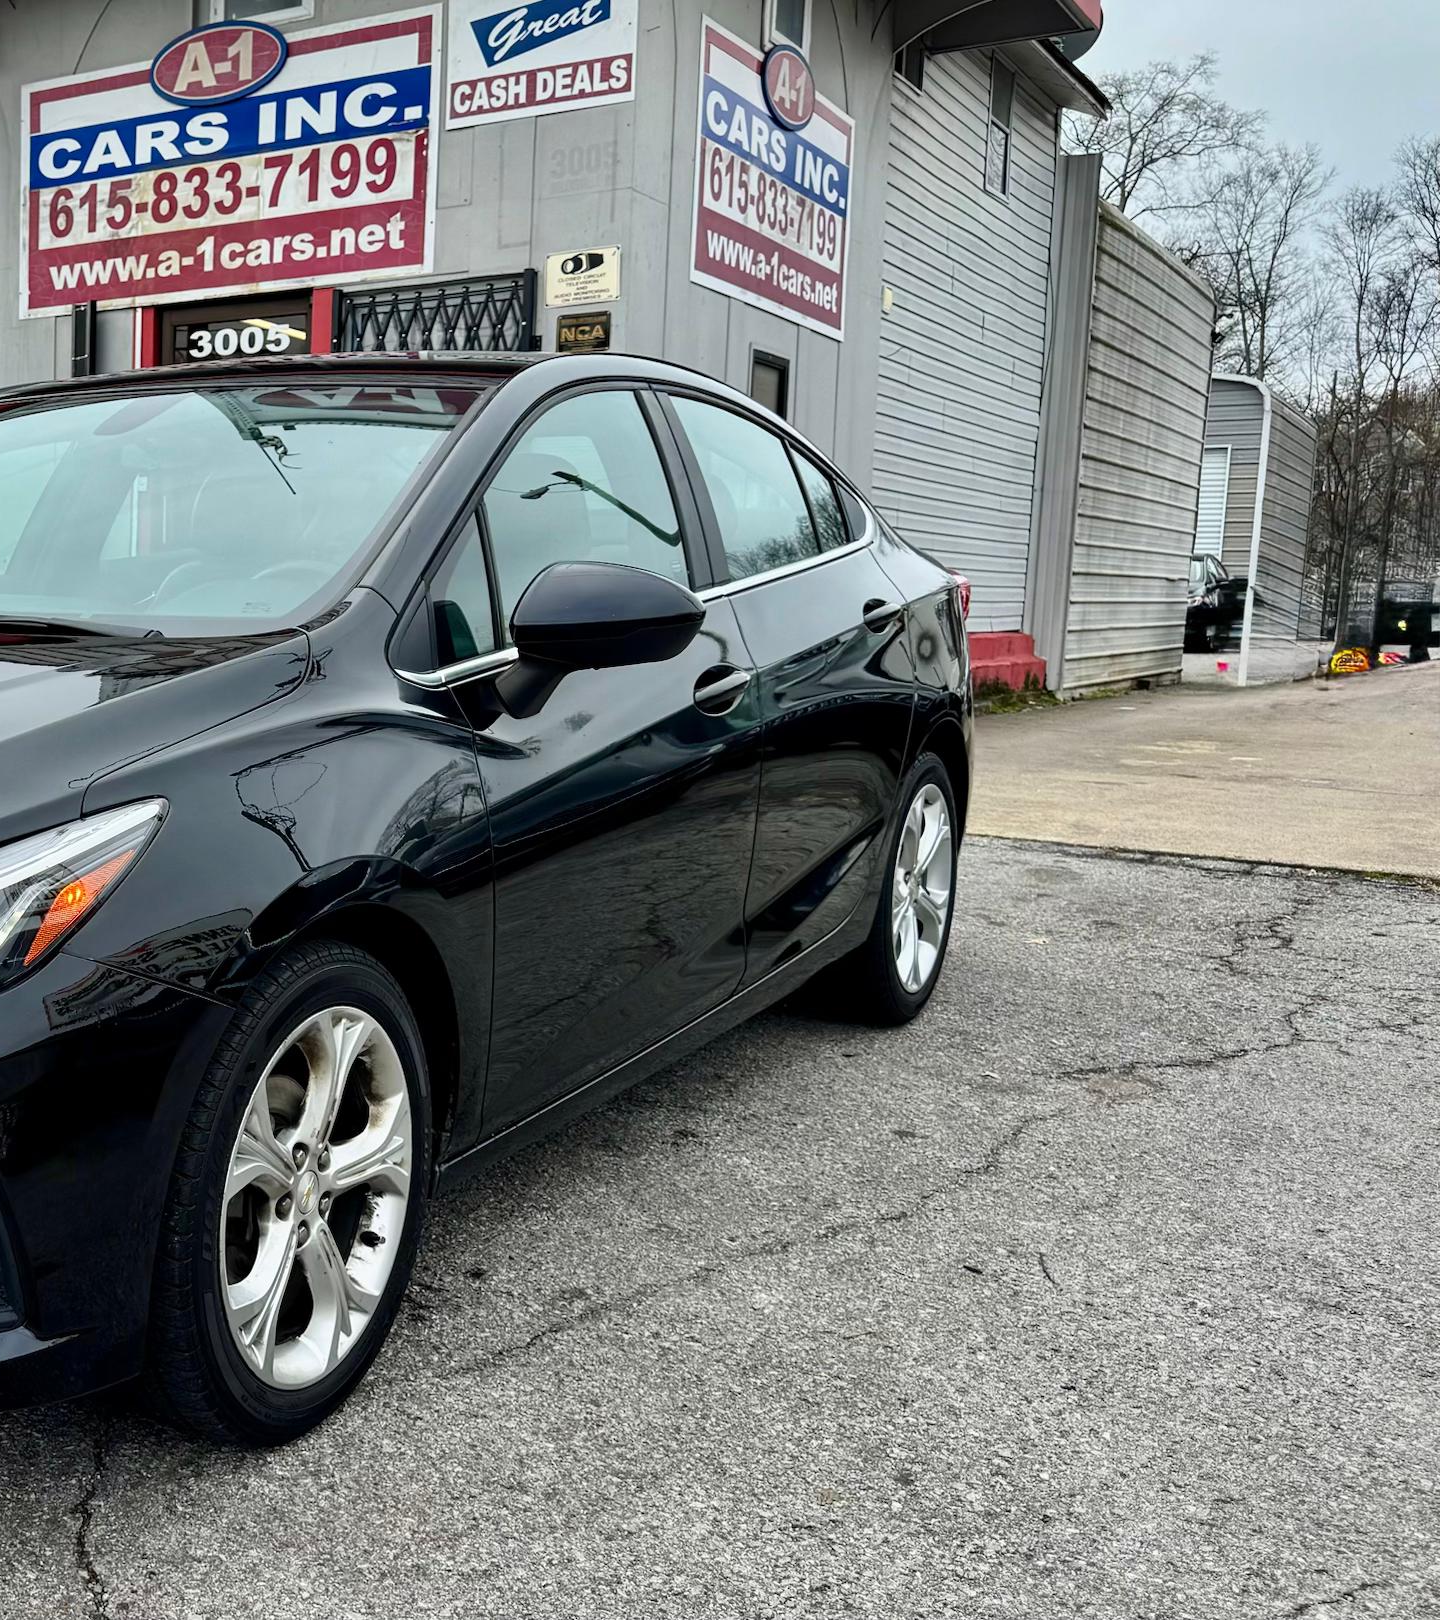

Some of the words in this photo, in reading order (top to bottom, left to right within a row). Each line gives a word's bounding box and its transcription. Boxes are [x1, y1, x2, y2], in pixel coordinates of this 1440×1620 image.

[173, 30, 255, 95] A-1
[487, 0, 605, 62] Great
[453, 75, 527, 115] CASH
[536, 58, 629, 102] DEALS
[772, 58, 807, 117] A-1
[38, 112, 230, 180] CARS
[259, 82, 423, 145] INC.
[706, 89, 787, 172] CARS
[795, 143, 845, 209] INC.
[49, 137, 398, 239] 615-833-7199
[709, 146, 836, 262] 615-833-7199
[50, 212, 406, 291] www.a-1cars.net
[707, 229, 838, 314] www.a-1cars.net
[189, 322, 292, 360] 3005
[560, 324, 606, 342] NCA
